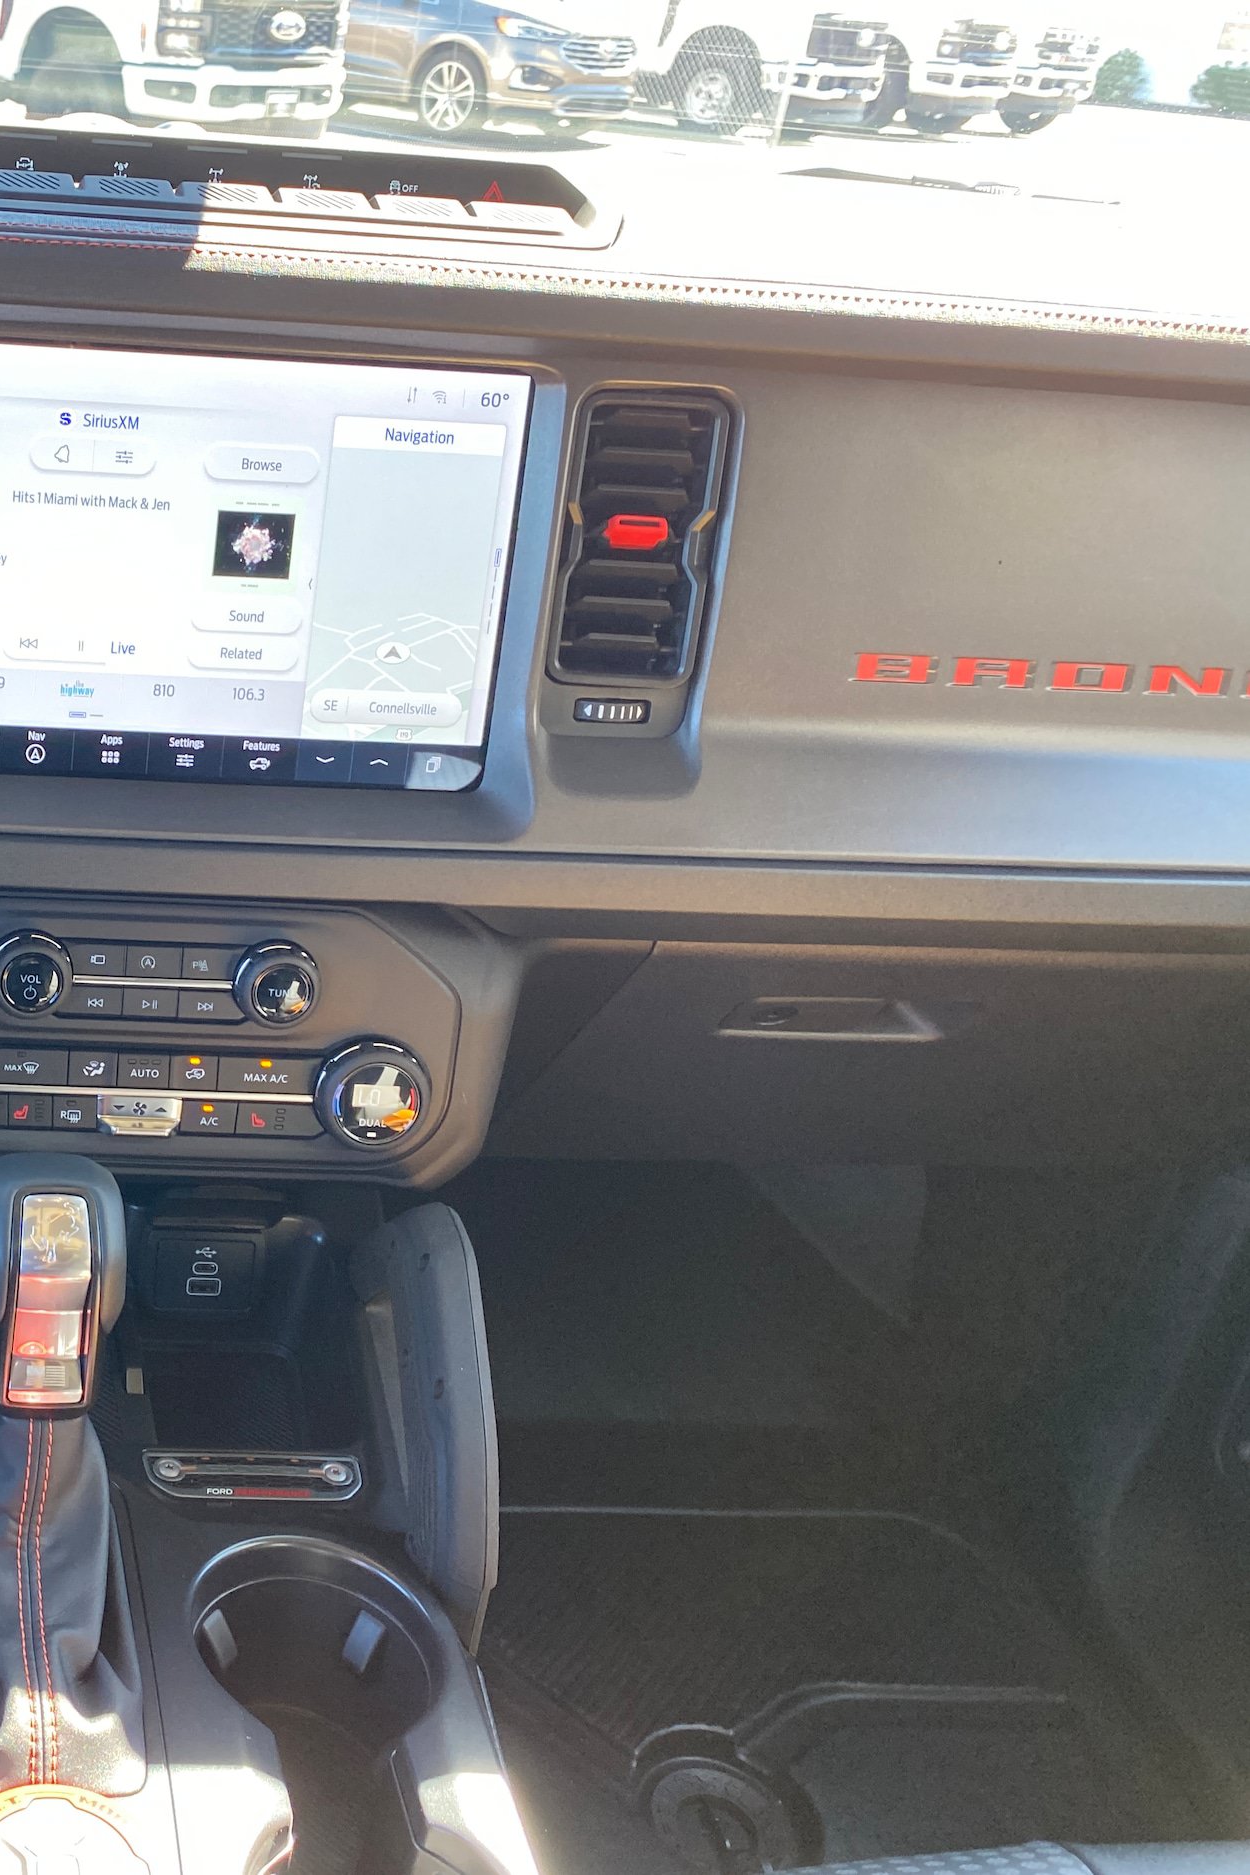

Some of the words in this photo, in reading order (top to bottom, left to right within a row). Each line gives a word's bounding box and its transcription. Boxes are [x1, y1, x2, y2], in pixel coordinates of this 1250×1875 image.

[401, 184, 419, 193] OFF
[480, 391, 510, 408] 60°
[82, 413, 139, 430] SiriusXM
[385, 427, 455, 446] Navigation
[241, 457, 282, 472] Browse
[12, 490, 34, 504] Hits
[37, 492, 43, 503] 1
[44, 492, 78, 506] Miami
[80, 494, 106, 508] with
[108, 496, 139, 510] Mack
[140, 498, 150, 510] &
[151, 499, 171, 511] Jen
[228, 610, 265, 623] Sound
[110, 641, 136, 655] Live
[220, 647, 263, 661] Related
[848, 652, 1250, 700] BRON
[59, 683, 95, 698] highway
[153, 684, 175, 698] 810
[232, 687, 265, 701] 106.3
[323, 700, 338, 712] SE
[368, 701, 438, 716] Connellsville
[28, 731, 46, 742] Nav
[100, 734, 123, 748] Apps
[168, 736, 205, 751] Settings
[243, 740, 281, 753] Features
[20, 974, 42, 985] VOL
[4, 1063, 23, 1073] MAX
[130, 1068, 160, 1079] AUTO
[243, 1073, 268, 1083] MAX
[269, 1074, 289, 1084] A/C
[200, 1117, 219, 1127] A/C
[358, 1118, 388, 1128] DUAL
[206, 1487, 233, 1495] FORD
